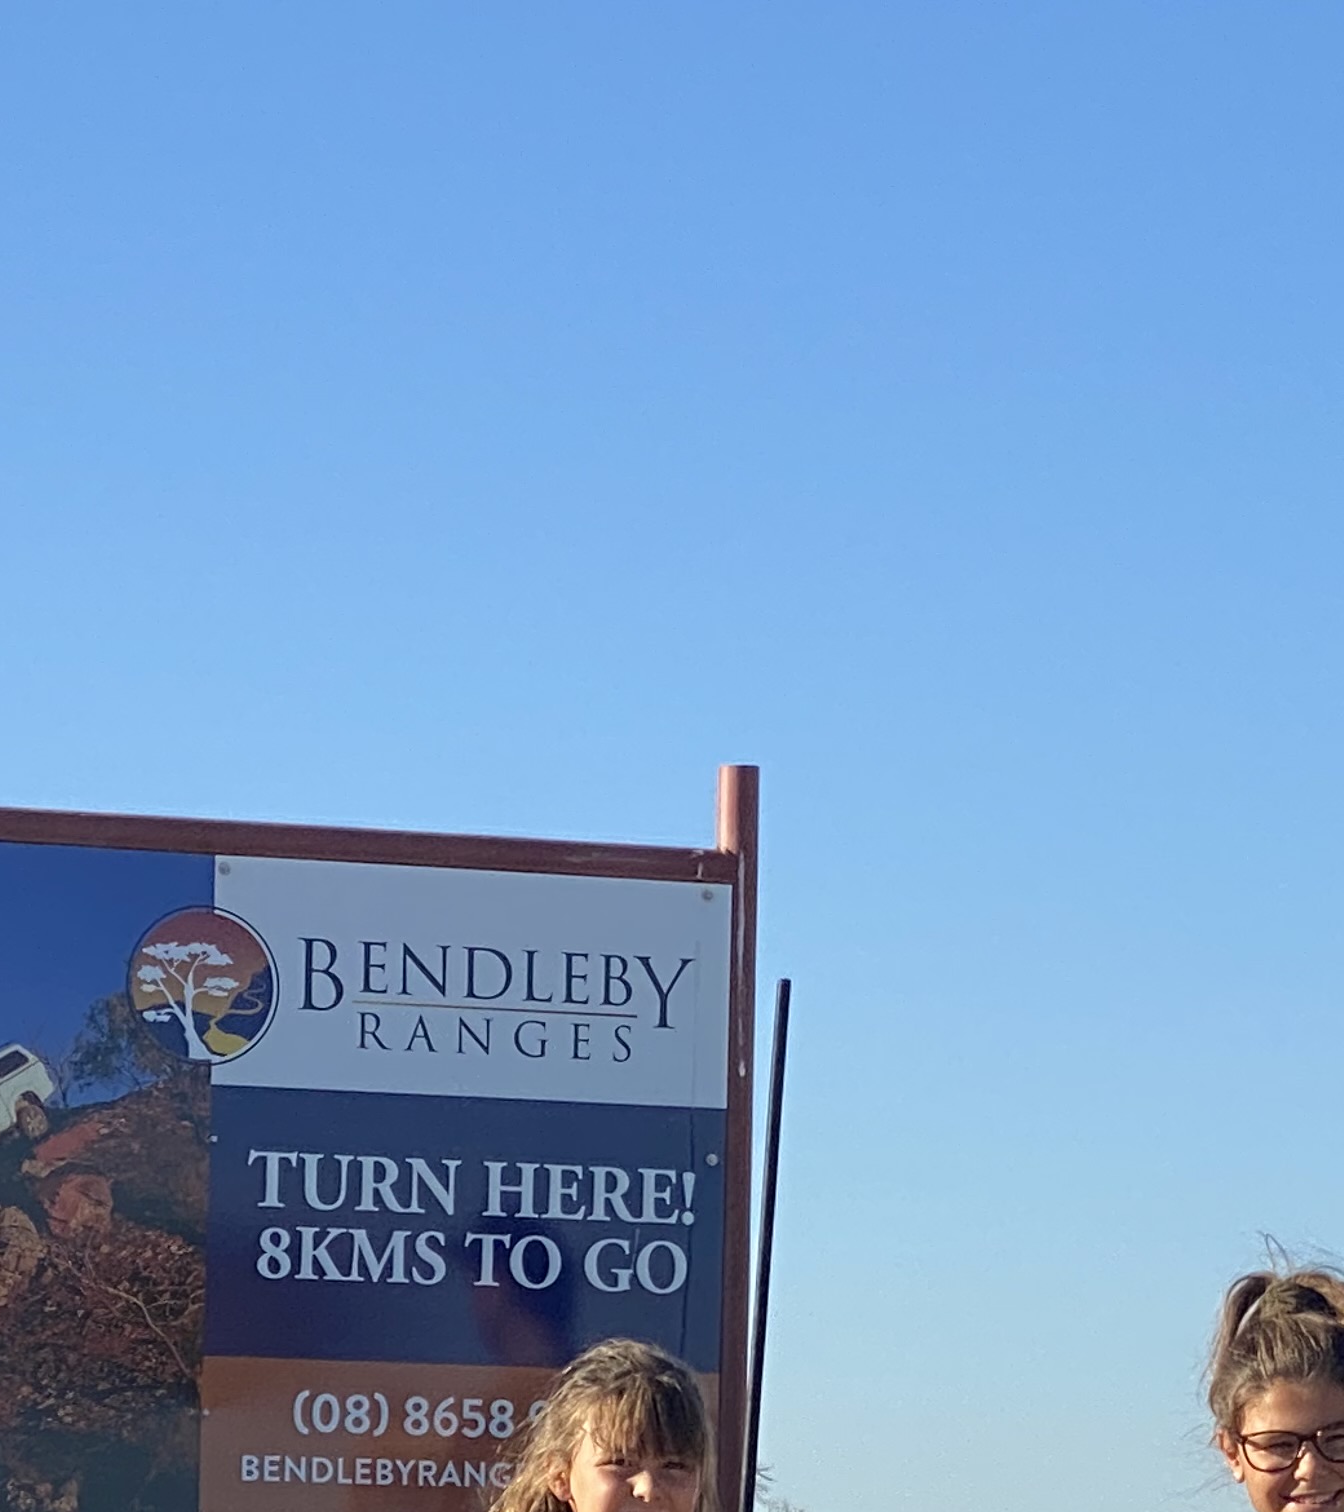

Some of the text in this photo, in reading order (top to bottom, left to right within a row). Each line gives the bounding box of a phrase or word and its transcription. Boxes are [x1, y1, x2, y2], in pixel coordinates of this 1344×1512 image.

[297, 936, 696, 1030] BENDLEBY
[356, 1012, 635, 1063] RANGES
[247, 1149, 697, 1226] TURN HERE!
[256, 1226, 688, 1295] 8KMS TO GO
[293, 1390, 390, 1437] (08)
[403, 1395, 515, 1439] 8658
[241, 1455, 522, 1489] BENDLEBYRANG
